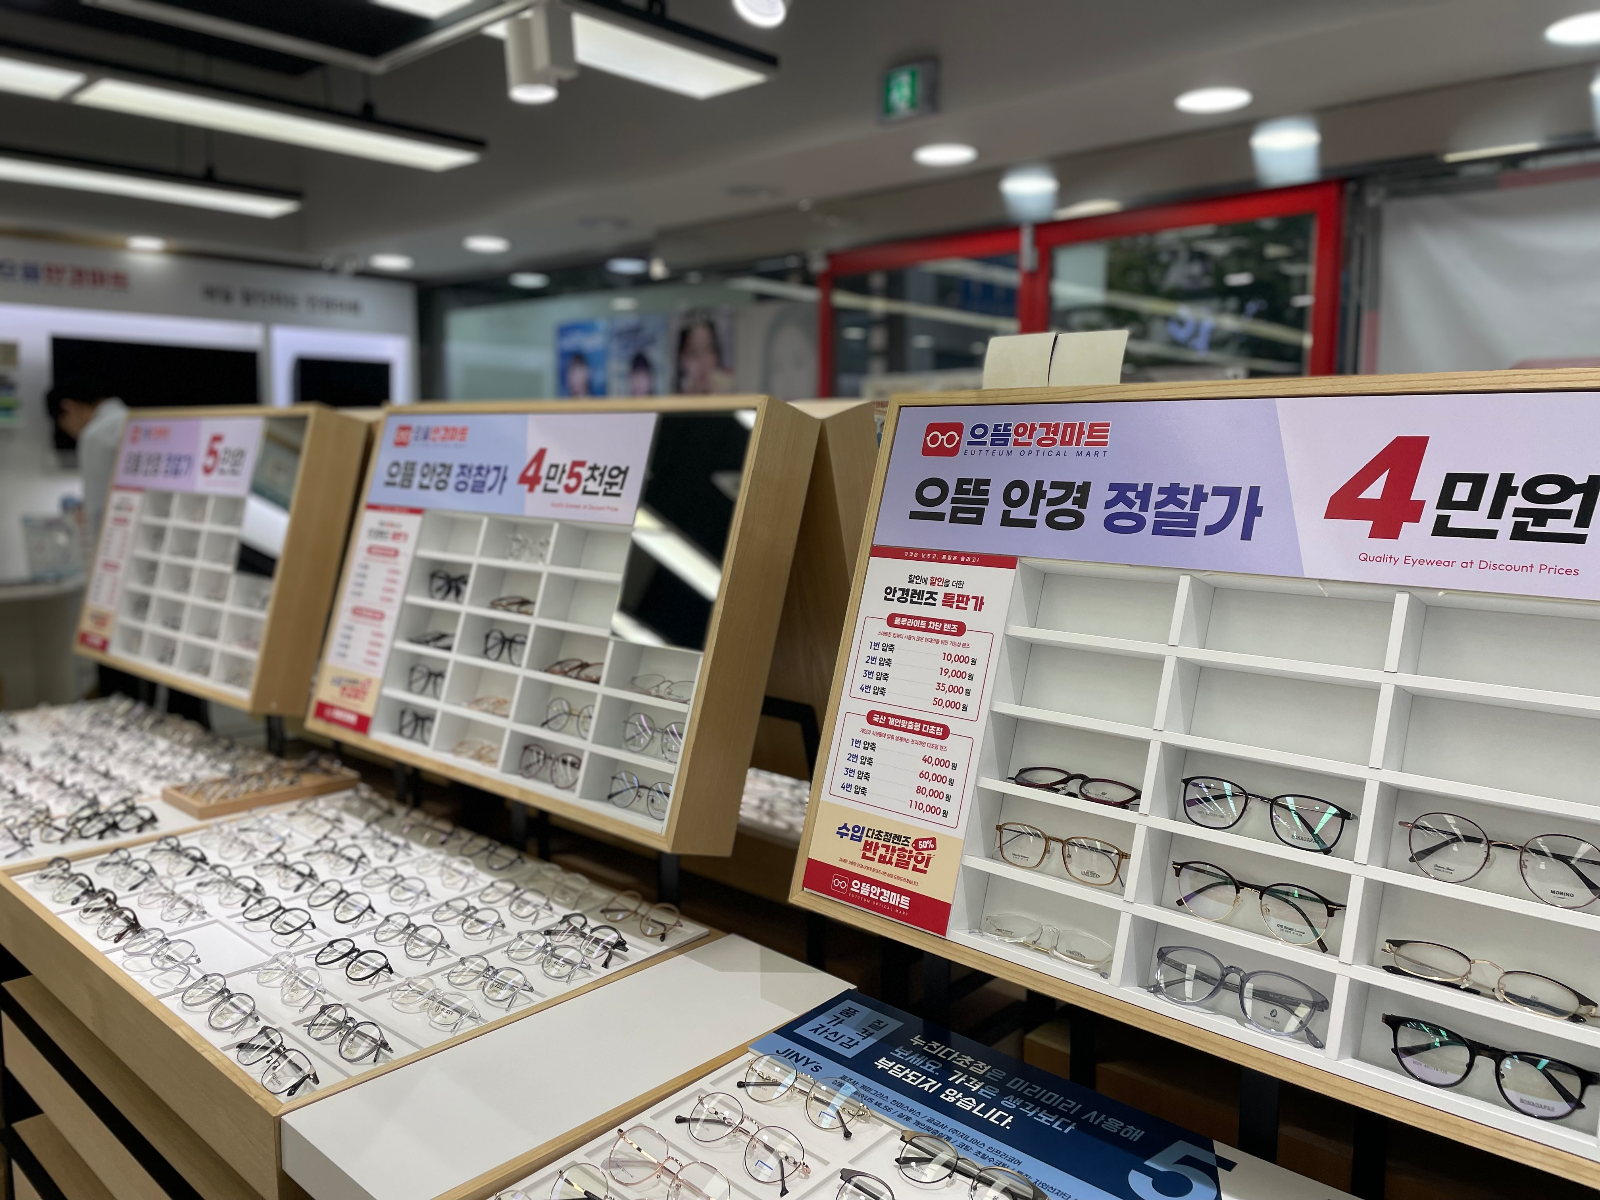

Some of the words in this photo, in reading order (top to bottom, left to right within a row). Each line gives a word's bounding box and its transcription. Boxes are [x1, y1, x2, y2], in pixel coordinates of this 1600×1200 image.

[966, 421, 1112, 447] 으뜸안경마트
[964, 449, 1013, 457] EUTTEUM
[1019, 449, 1069, 457] OPTICAL
[1075, 450, 1108, 458] MART
[417, 461, 453, 491] 안경
[454, 463, 508, 495] 정찰가
[517, 447, 630, 498] 4만5천원
[1324, 436, 1600, 544] 4만원
[909, 477, 992, 526] 으뜸
[1000, 479, 1091, 531] 안경
[1103, 482, 1263, 541] 정찰가
[1358, 553, 1400, 566] Quality
[1403, 555, 1457, 568] Eyewear
[1460, 559, 1475, 569] at
[1478, 560, 1534, 573] Discount
[1538, 563, 1580, 576] Prices
[908, 574, 928, 585] 할인에
[929, 576, 950, 588] 할인을
[884, 586, 938, 607] 안경렌즈
[941, 592, 985, 612] 특판가
[894, 616, 927, 628] 블루라이트
[928, 621, 942, 631] 차단
[943, 623, 959, 633] 렌즈
[869, 641, 880, 651] 1번
[881, 642, 895, 654] 압축
[865, 655, 877, 665] 2번
[878, 656, 892, 668] 압축
[862, 669, 875, 680] 3번
[875, 670, 889, 682] 압축
[859, 684, 872, 694] 4번
[872, 685, 887, 697] 압축
[872, 714, 886, 724] 국산
[922, 724, 944, 736] 다초점
[850, 738, 862, 749] 1번
[863, 740, 877, 752] 압축
[847, 753, 859, 763] 2번
[860, 755, 874, 766] 압축
[843, 767, 856, 778] 3번
[857, 770, 871, 782] 압축
[840, 782, 853, 793] 4번
[854, 784, 868, 796] 압축
[836, 823, 866, 842] 수입
[866, 828, 911, 847] 다초점렌즈
[861, 840, 932, 874] 반값할인
[850, 879, 911, 910] 으뜸안경마트
[827, 1014, 845, 1027] 가
[856, 1028, 875, 1040] 격
[838, 1006, 860, 1019] 품
[868, 1019, 889, 1032] 질
[808, 1024, 860, 1050] 자신감
[874, 1057, 942, 1094] 부담되지
[940, 1088, 1014, 1130] 않습니다.
[890, 1045, 942, 1076] 보세요.
[948, 1070, 1000, 1099] 가격은
[1000, 1094, 1077, 1134] 생각보다
[910, 1034, 1007, 1082] 누진다초점은
[1006, 1076, 1082, 1114] 미리미리
[1082, 1110, 1146, 1142] 사용해
[1128, 1140, 1238, 1200] 5
